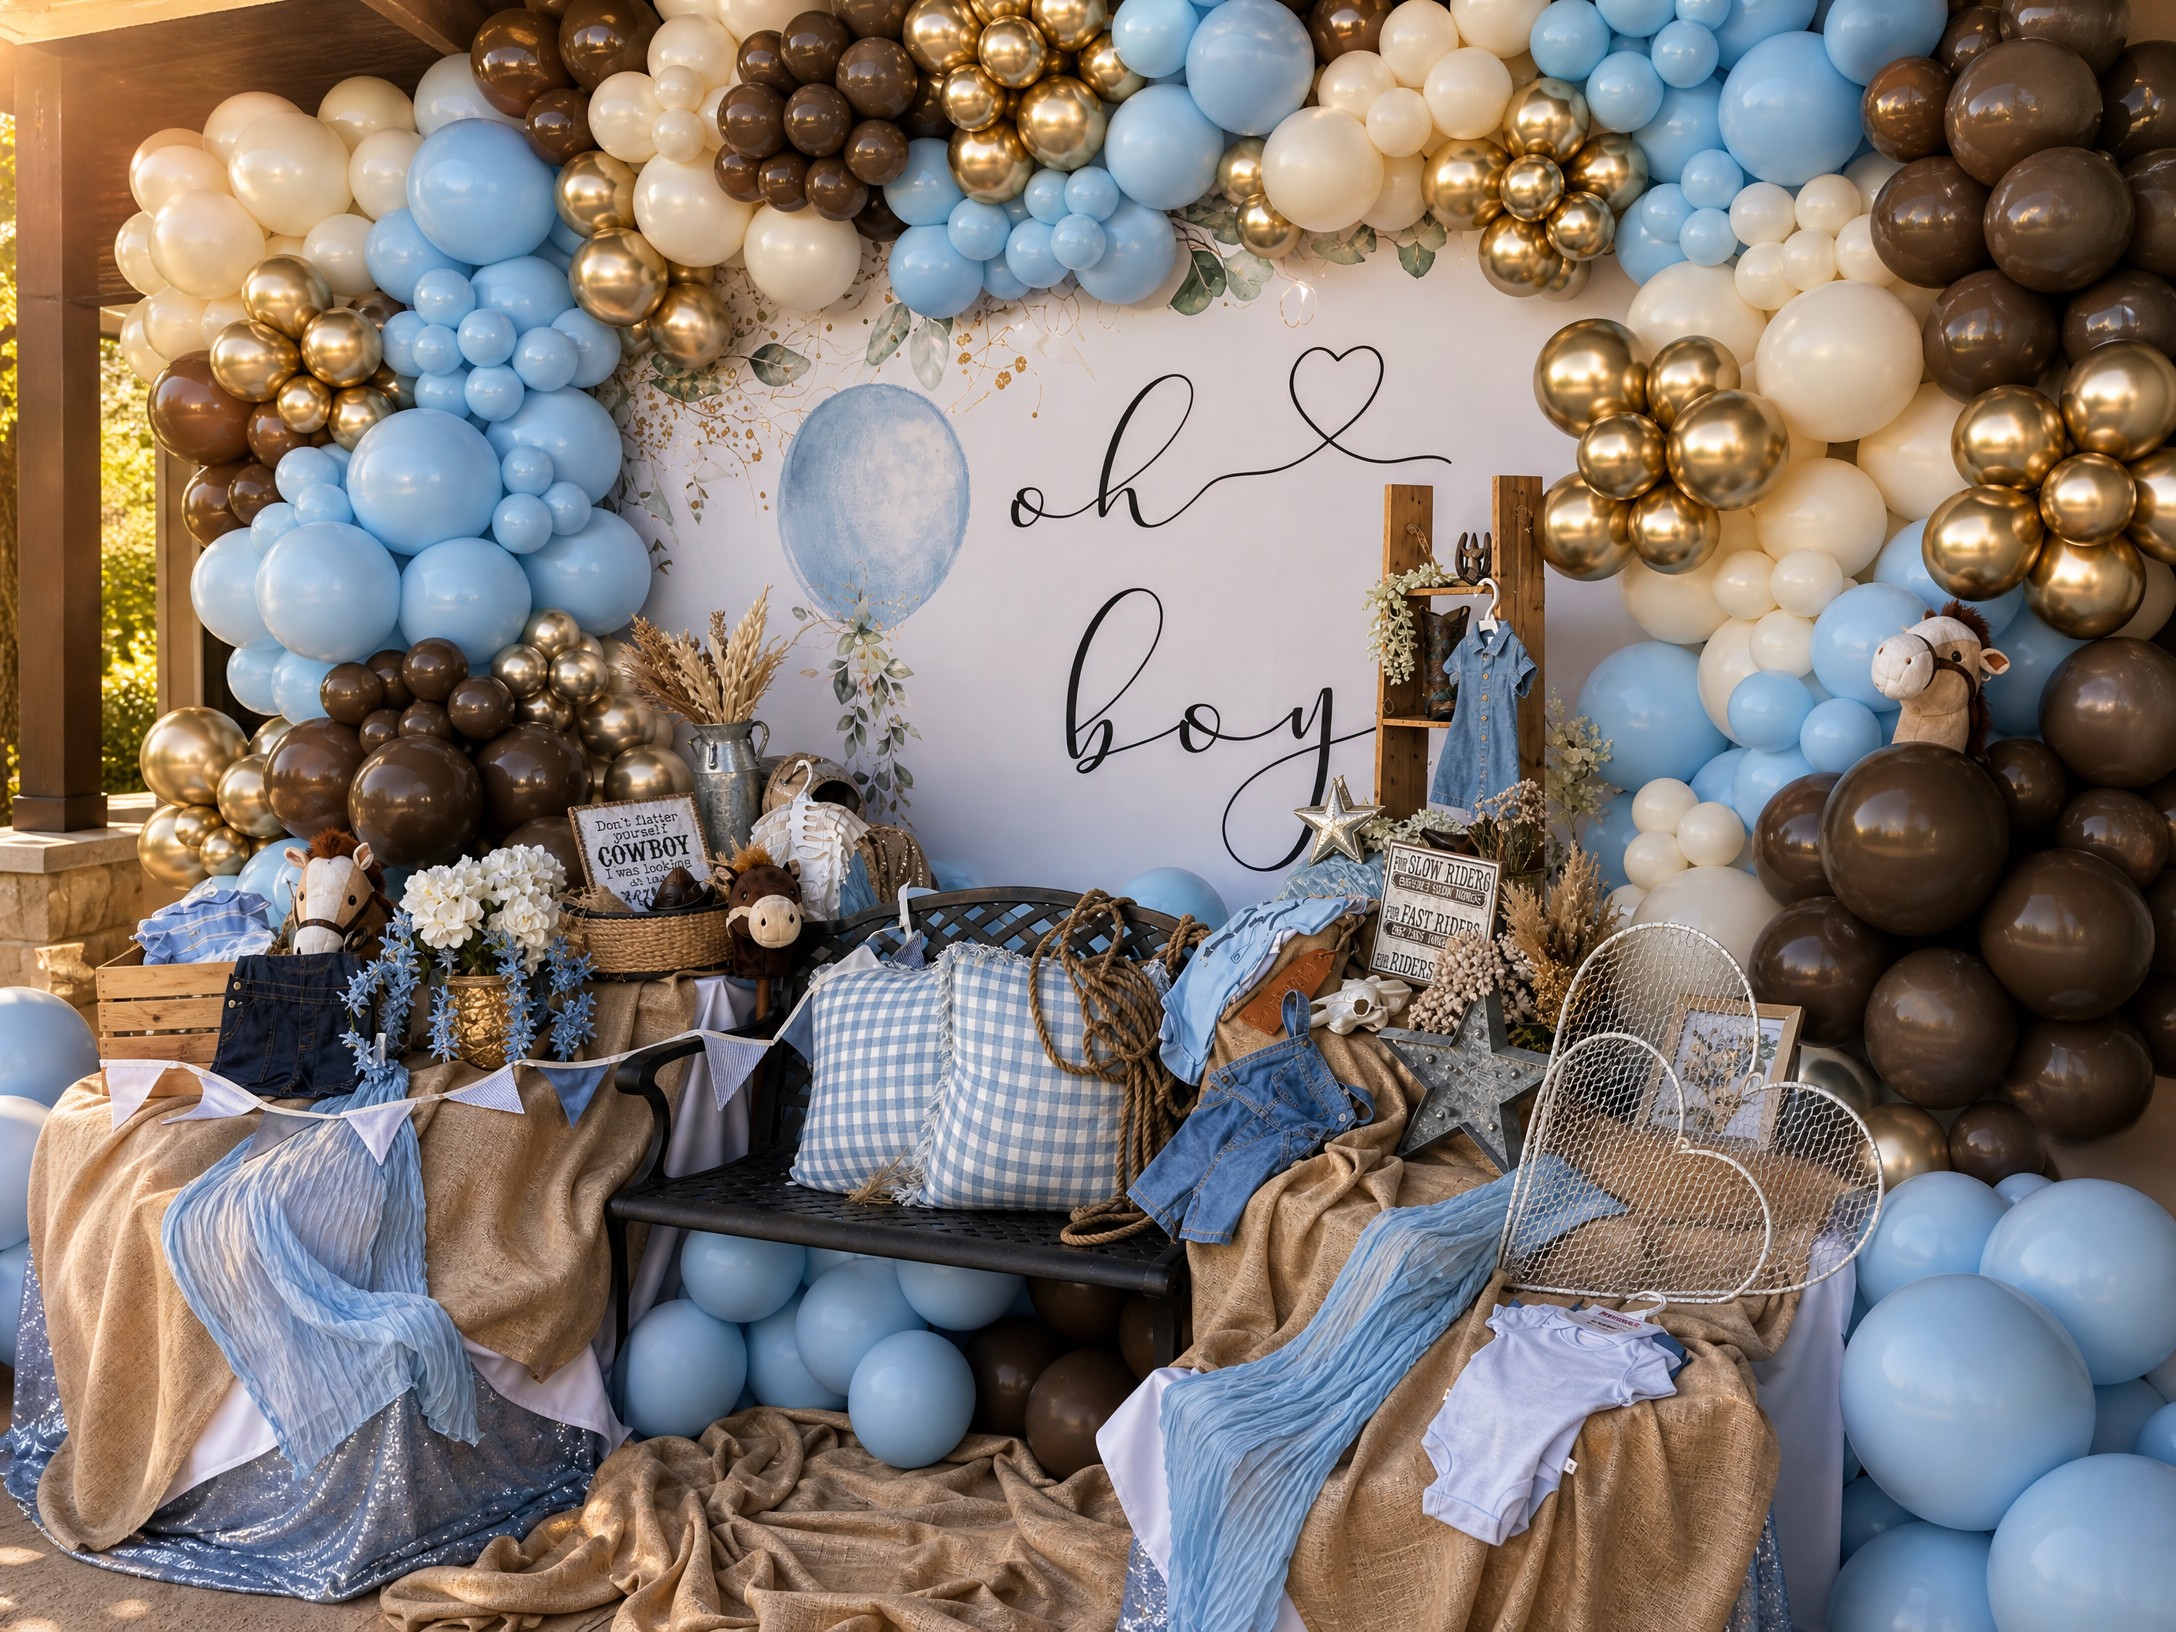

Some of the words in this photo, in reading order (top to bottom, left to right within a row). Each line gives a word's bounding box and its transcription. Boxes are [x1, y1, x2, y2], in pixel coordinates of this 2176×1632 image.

[1010, 373, 1225, 529] oh
[1065, 587, 1377, 872] boy
[595, 817, 632, 832] Don't
[635, 813, 679, 826] flatter
[597, 834, 690, 868] COWBOY
[605, 868, 613, 880] I
[615, 866, 640, 878] was
[1408, 854, 1444, 881] SLOW
[1400, 903, 1434, 929] FAST
[1389, 951, 1436, 980] RIDERS
